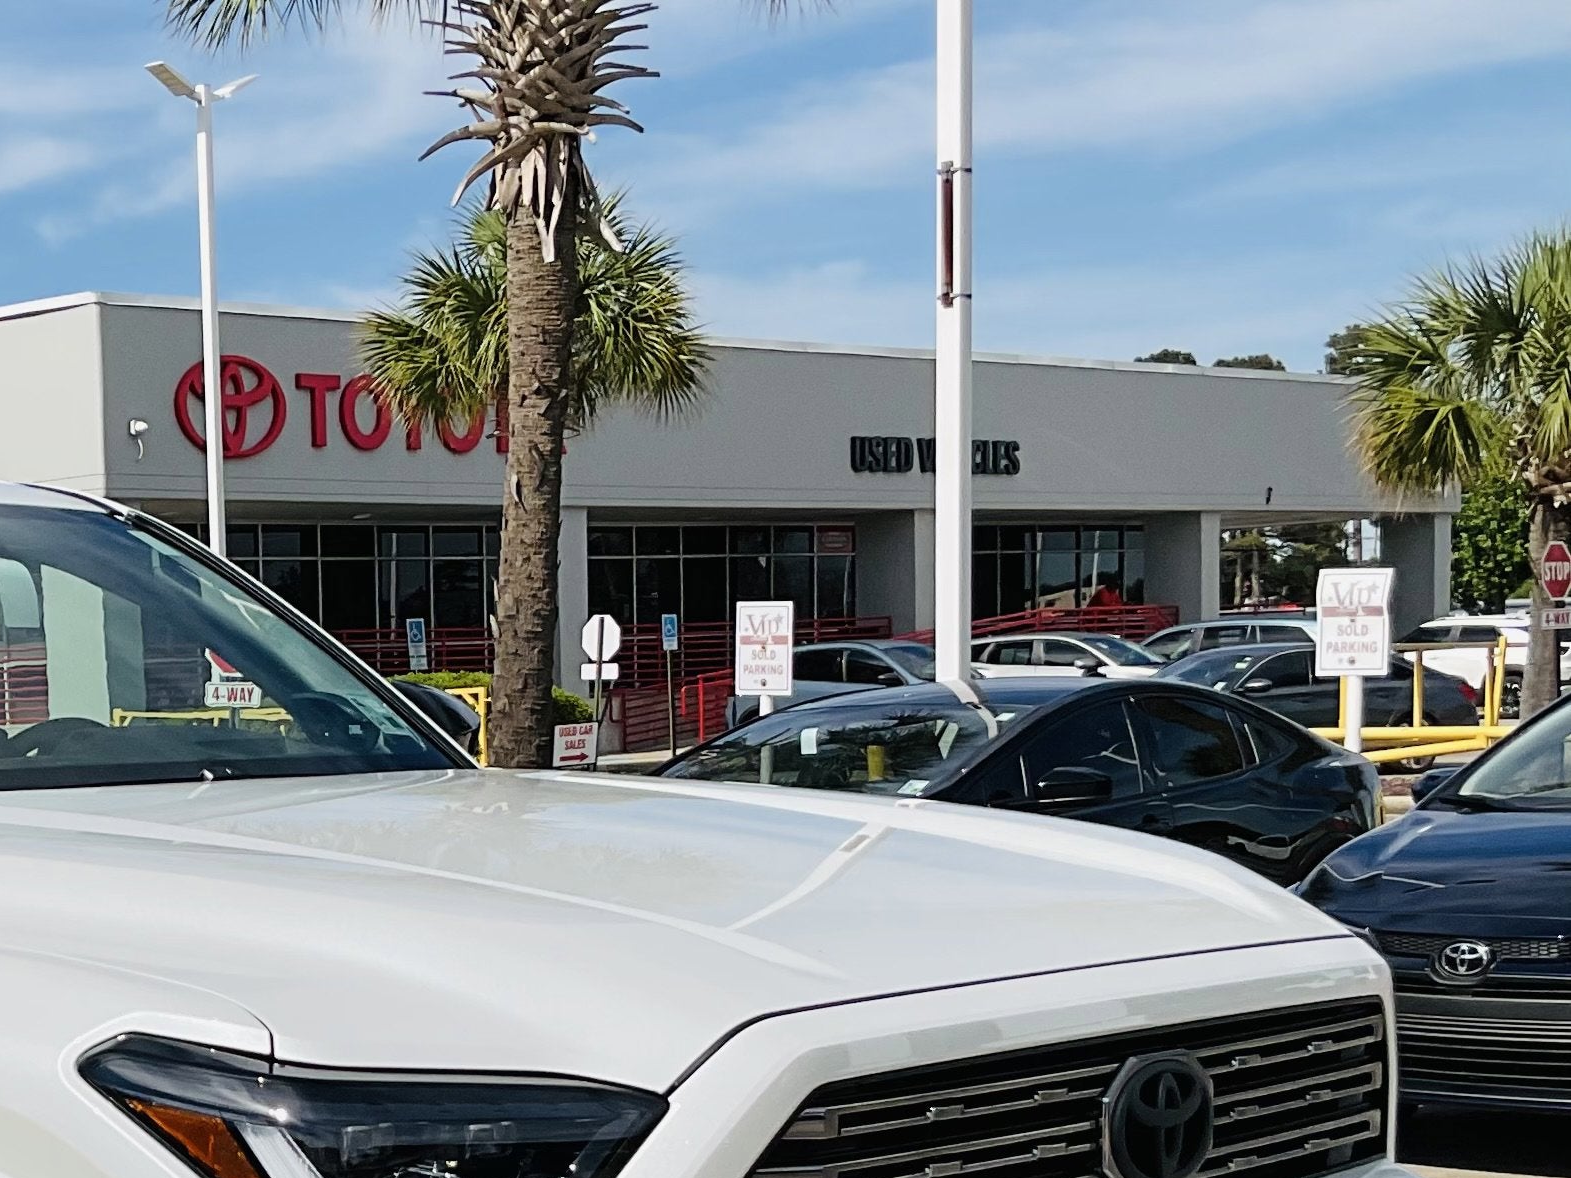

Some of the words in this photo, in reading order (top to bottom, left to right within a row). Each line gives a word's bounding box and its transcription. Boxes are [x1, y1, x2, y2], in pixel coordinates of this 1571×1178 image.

[850, 436, 914, 473] USED
[916, 437, 1020, 475] VCLES
[1544, 562, 1570, 580] STOP
[1337, 624, 1369, 637] SOLD
[1325, 641, 1378, 653] PARKING
[751, 649, 777, 660] SOLD
[743, 664, 784, 675] PARKING
[212, 686, 255, 703] 4-WAY
[559, 726, 577, 737] USED
[579, 724, 594, 735] CAR
[565, 739, 586, 750] SALES
